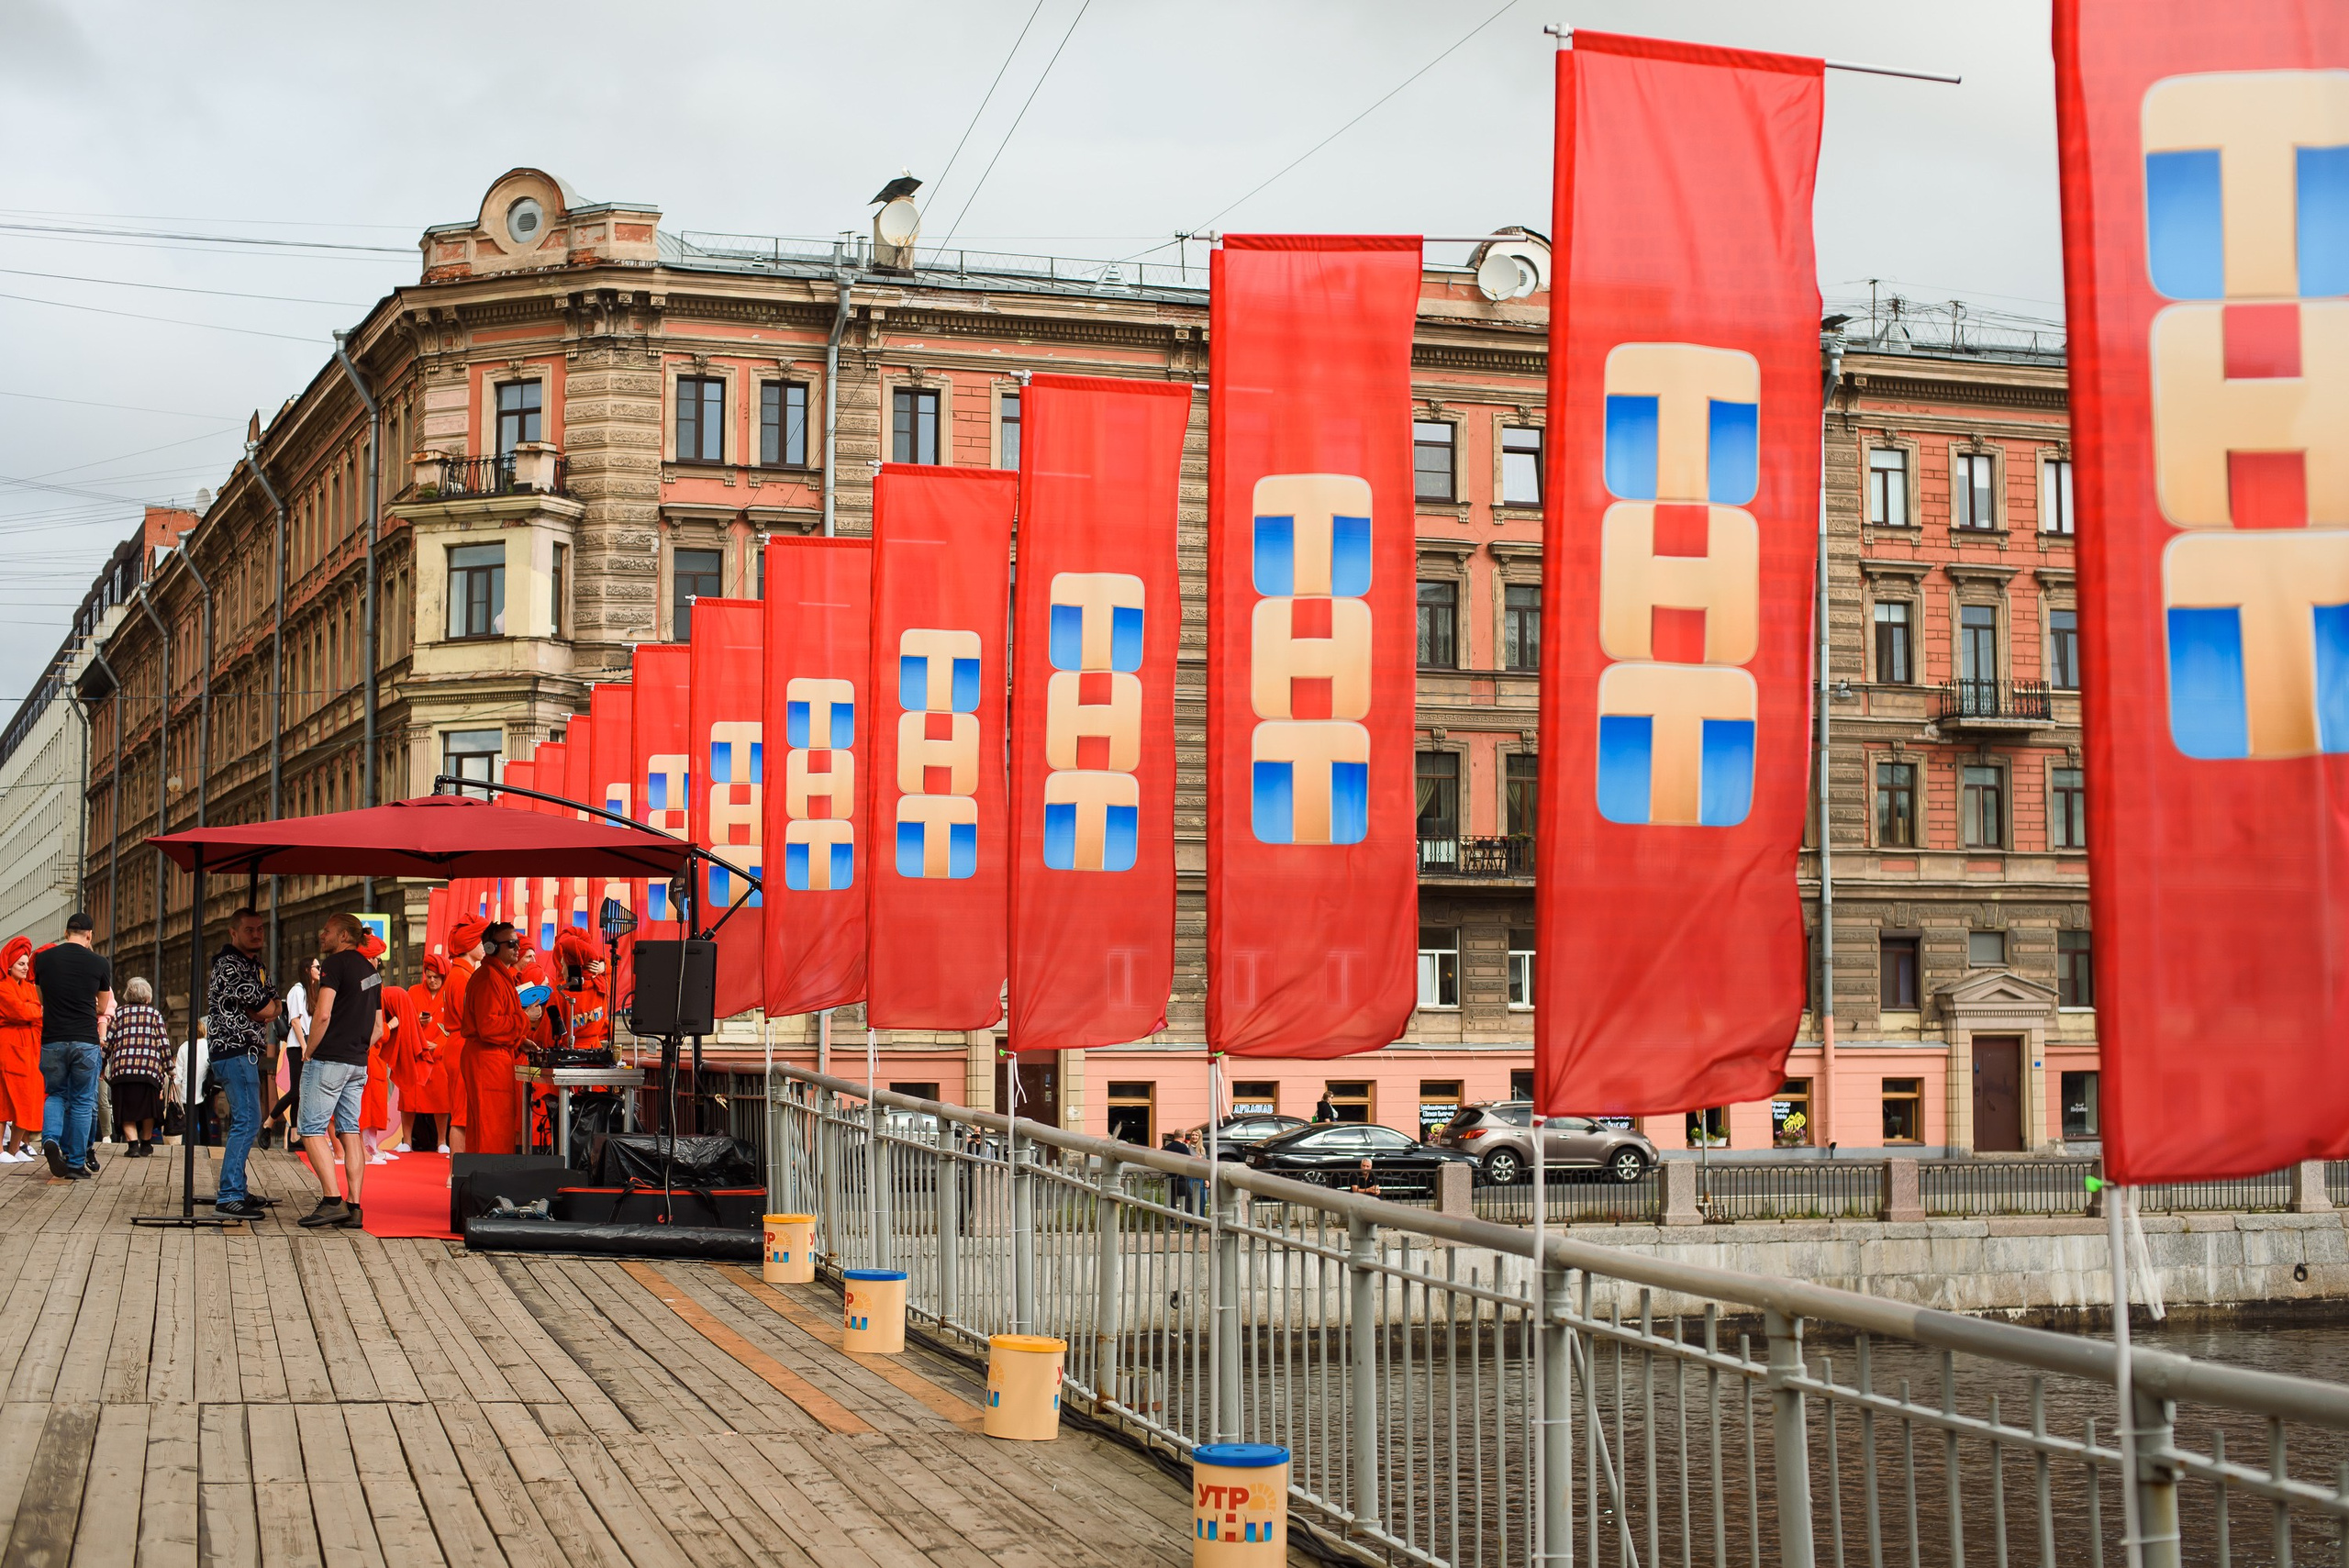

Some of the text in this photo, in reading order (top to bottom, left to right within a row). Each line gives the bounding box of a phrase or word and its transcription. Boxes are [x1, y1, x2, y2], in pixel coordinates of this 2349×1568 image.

[1043, 572, 1145, 871] ТНТ
[1251, 473, 1373, 845] ТНТ
[1596, 341, 1761, 827] ТНТ
[785, 677, 854, 891] ТНТ
[896, 628, 982, 879] ТНТ
